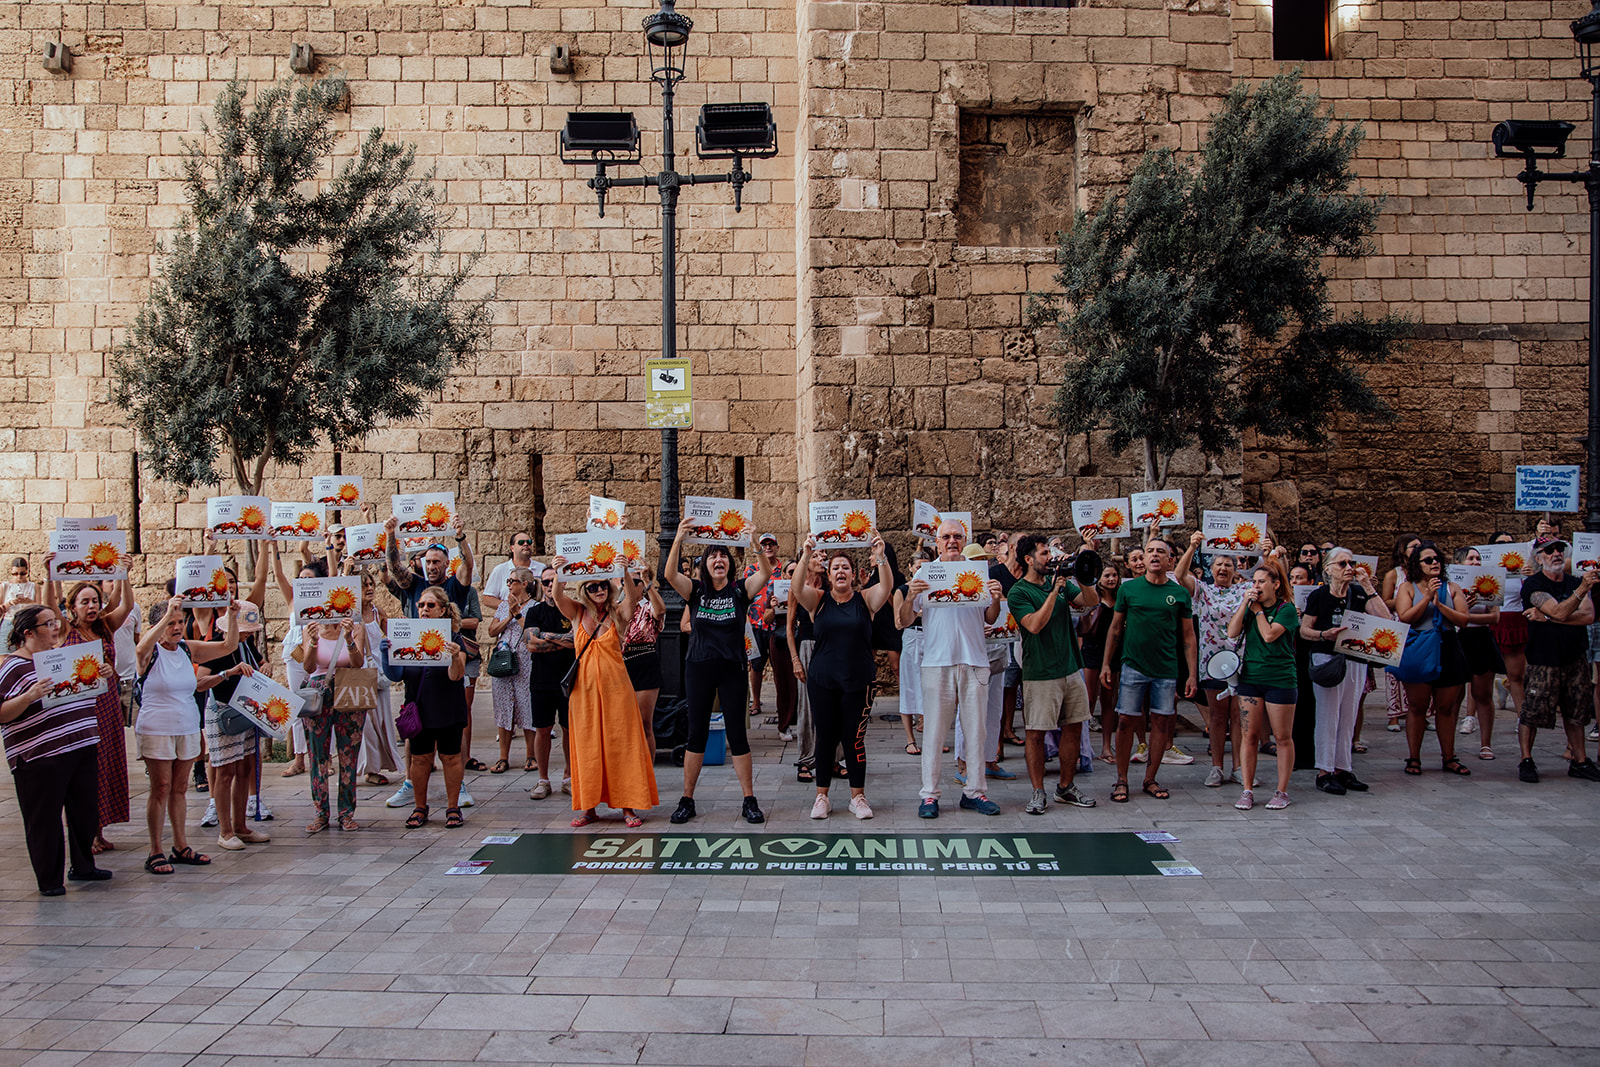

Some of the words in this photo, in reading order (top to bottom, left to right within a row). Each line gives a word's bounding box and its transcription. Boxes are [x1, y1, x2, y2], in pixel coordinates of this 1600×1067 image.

[51, 664, 62, 672] JA!
[334, 686, 378, 707] ZARA
[583, 838, 754, 858] SATYA
[825, 838, 1056, 858] ANIMAL
[572, 861, 656, 870] PORQUE
[660, 861, 724, 870] ELLOS
[730, 862, 759, 870] NO
[766, 862, 848, 871] PUEDEN
[941, 862, 998, 871] PERO
[1003, 860, 1031, 871] TÚ
[1037, 860, 1060, 871] SÍ
